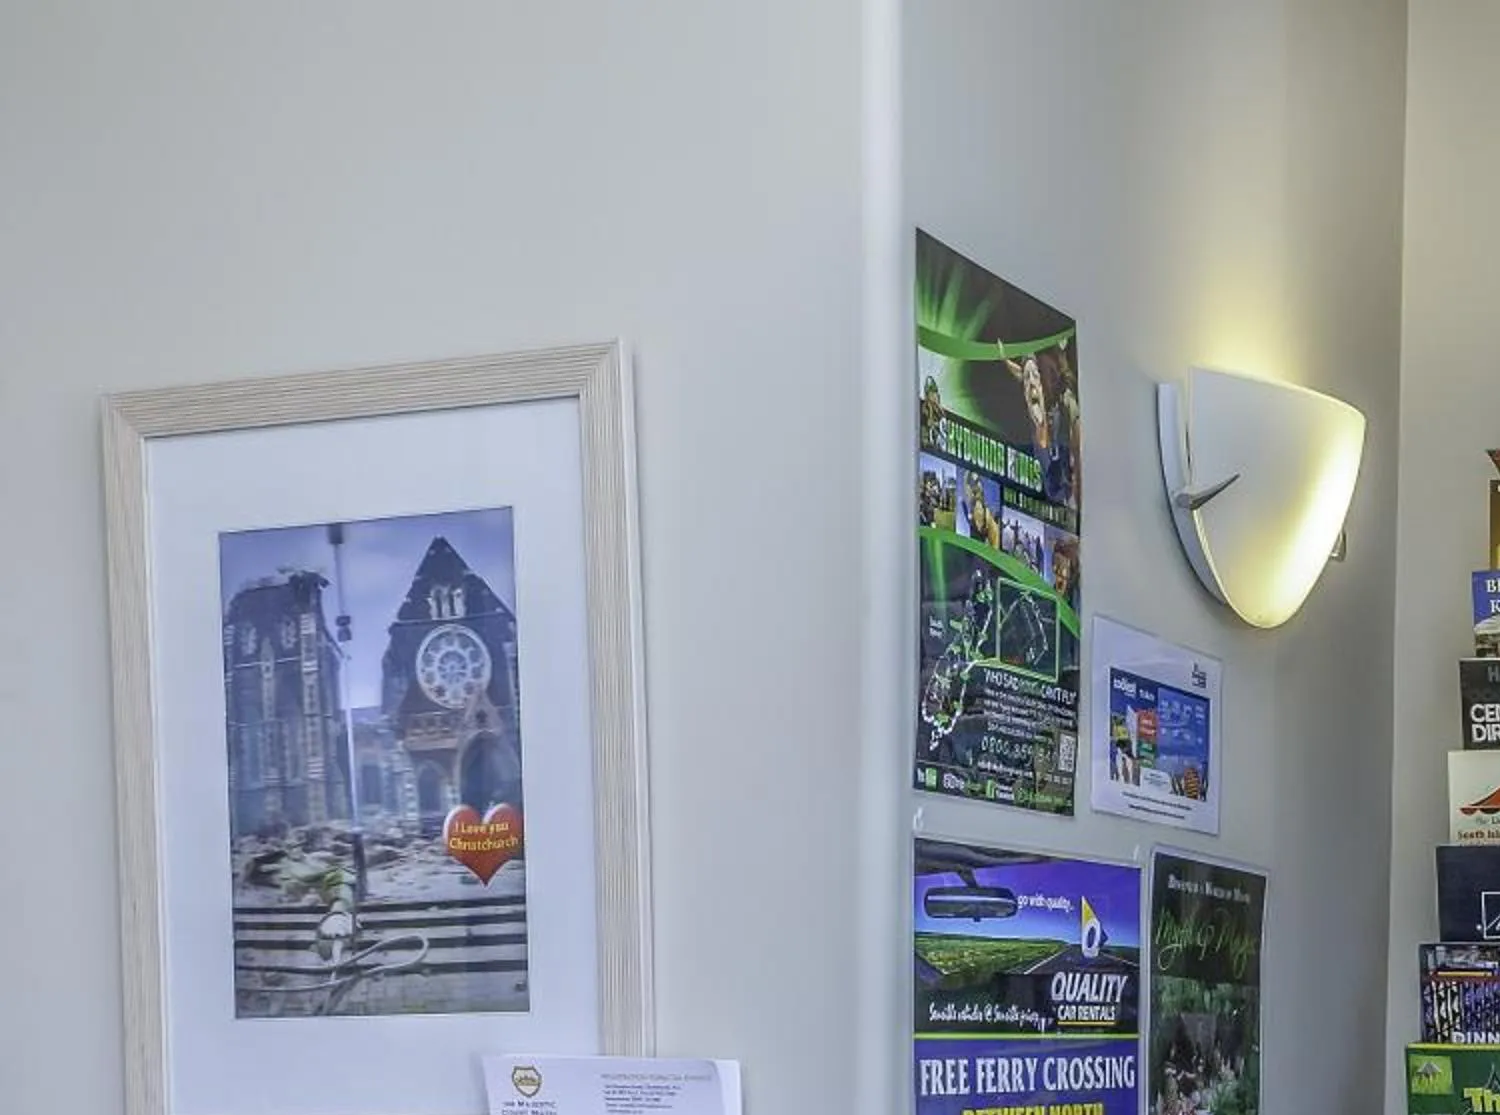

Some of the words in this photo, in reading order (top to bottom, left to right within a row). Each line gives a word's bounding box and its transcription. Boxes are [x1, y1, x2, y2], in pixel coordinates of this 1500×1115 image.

[448, 835, 519, 852] Christchurch
[1052, 972, 1128, 1003] QUALITY
[920, 1058, 969, 1096] FREE
[976, 1056, 1037, 1095] FERRY
[1043, 1055, 1136, 1092] CROSSING
